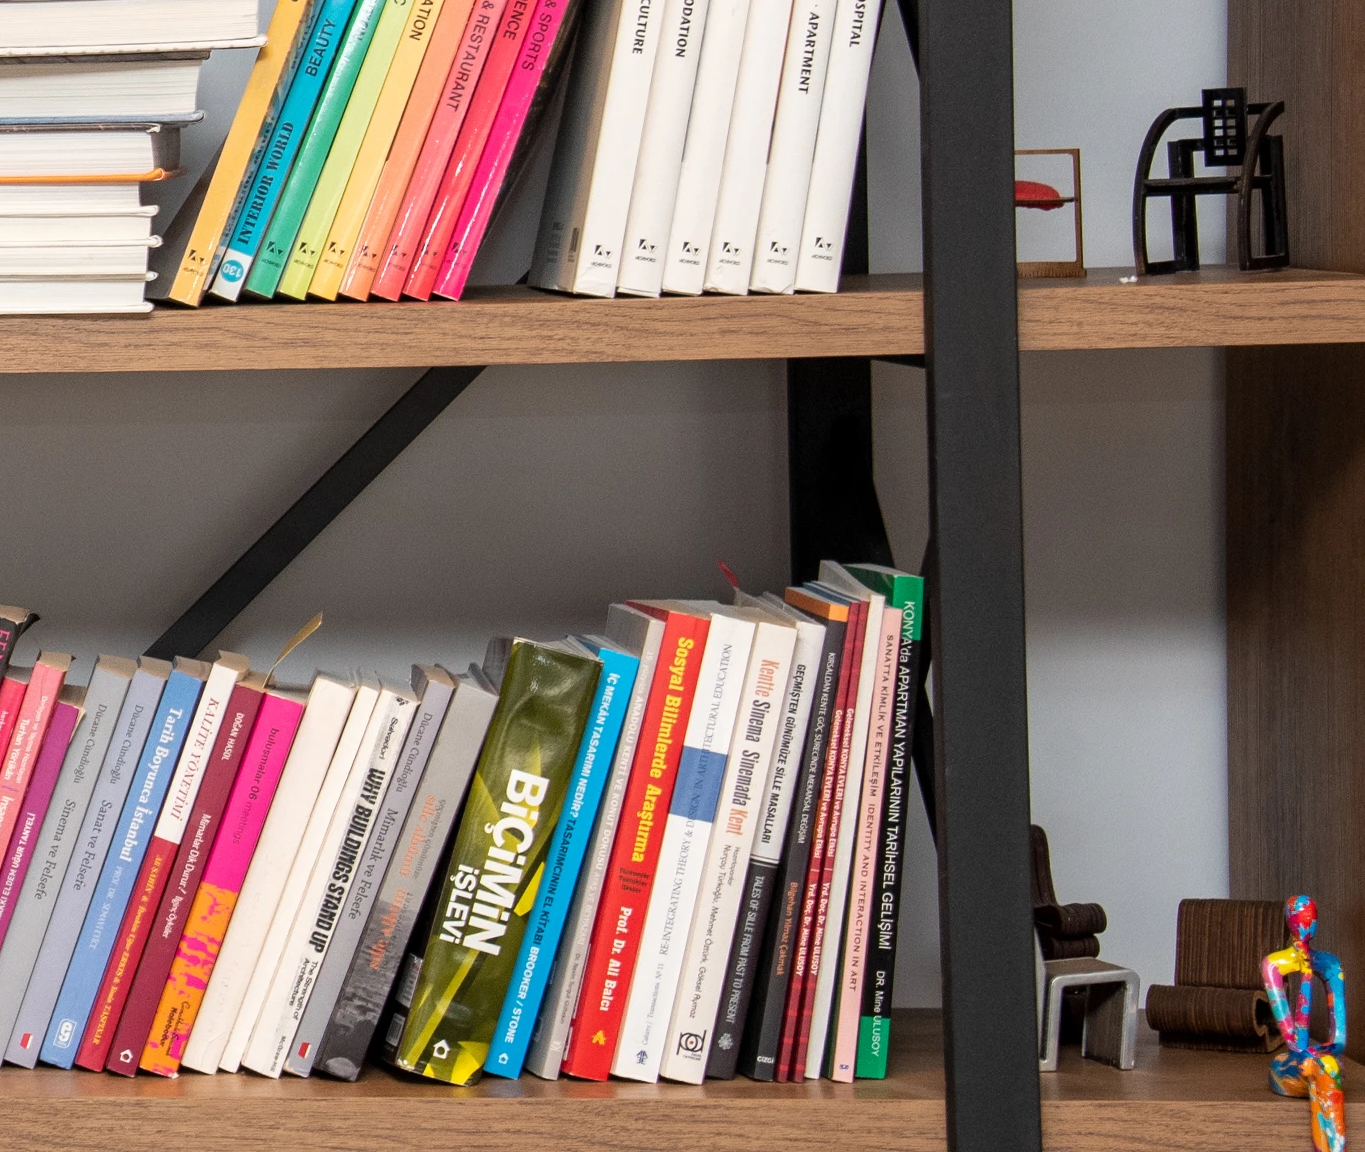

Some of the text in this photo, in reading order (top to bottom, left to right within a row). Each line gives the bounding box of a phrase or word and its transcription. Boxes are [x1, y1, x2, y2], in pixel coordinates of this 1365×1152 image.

[304, 18, 336, 77] BEAUTY
[446, 13, 490, 112] RESTAURANT
[520, 15, 551, 71] SPORTS
[797, 11, 820, 94] APARTMENT
[236, 174, 273, 244] INTERIOR
[265, 121, 293, 170] WORLD
[222, 262, 242, 277] 130
[877, 685, 889, 721] KİMLİK
[881, 634, 894, 682] SANATTA
[118, 707, 183, 862] Tarih Boyunca İstanbul
[631, 636, 694, 862] Sosyal Bilimlerde Araştırma
[725, 658, 780, 836] Kentte Sinema Sinemada Kent
[868, 740, 882, 797] ETKİLEŞİM
[876, 600, 915, 949] KONYA'da APARTMAN YAPILARININ TARİHSEL GELİŞİMİ
[33, 798, 76, 900] Sinema ve Felsefe
[72, 799, 112, 891] Sanat ve Felsefe
[308, 767, 385, 953] WHY BUILDINGS STAND UP
[347, 807, 399, 920] Mimarlık ve Felsefe
[599, 906, 632, 1011] Prof. Dr. Ali Balcı
